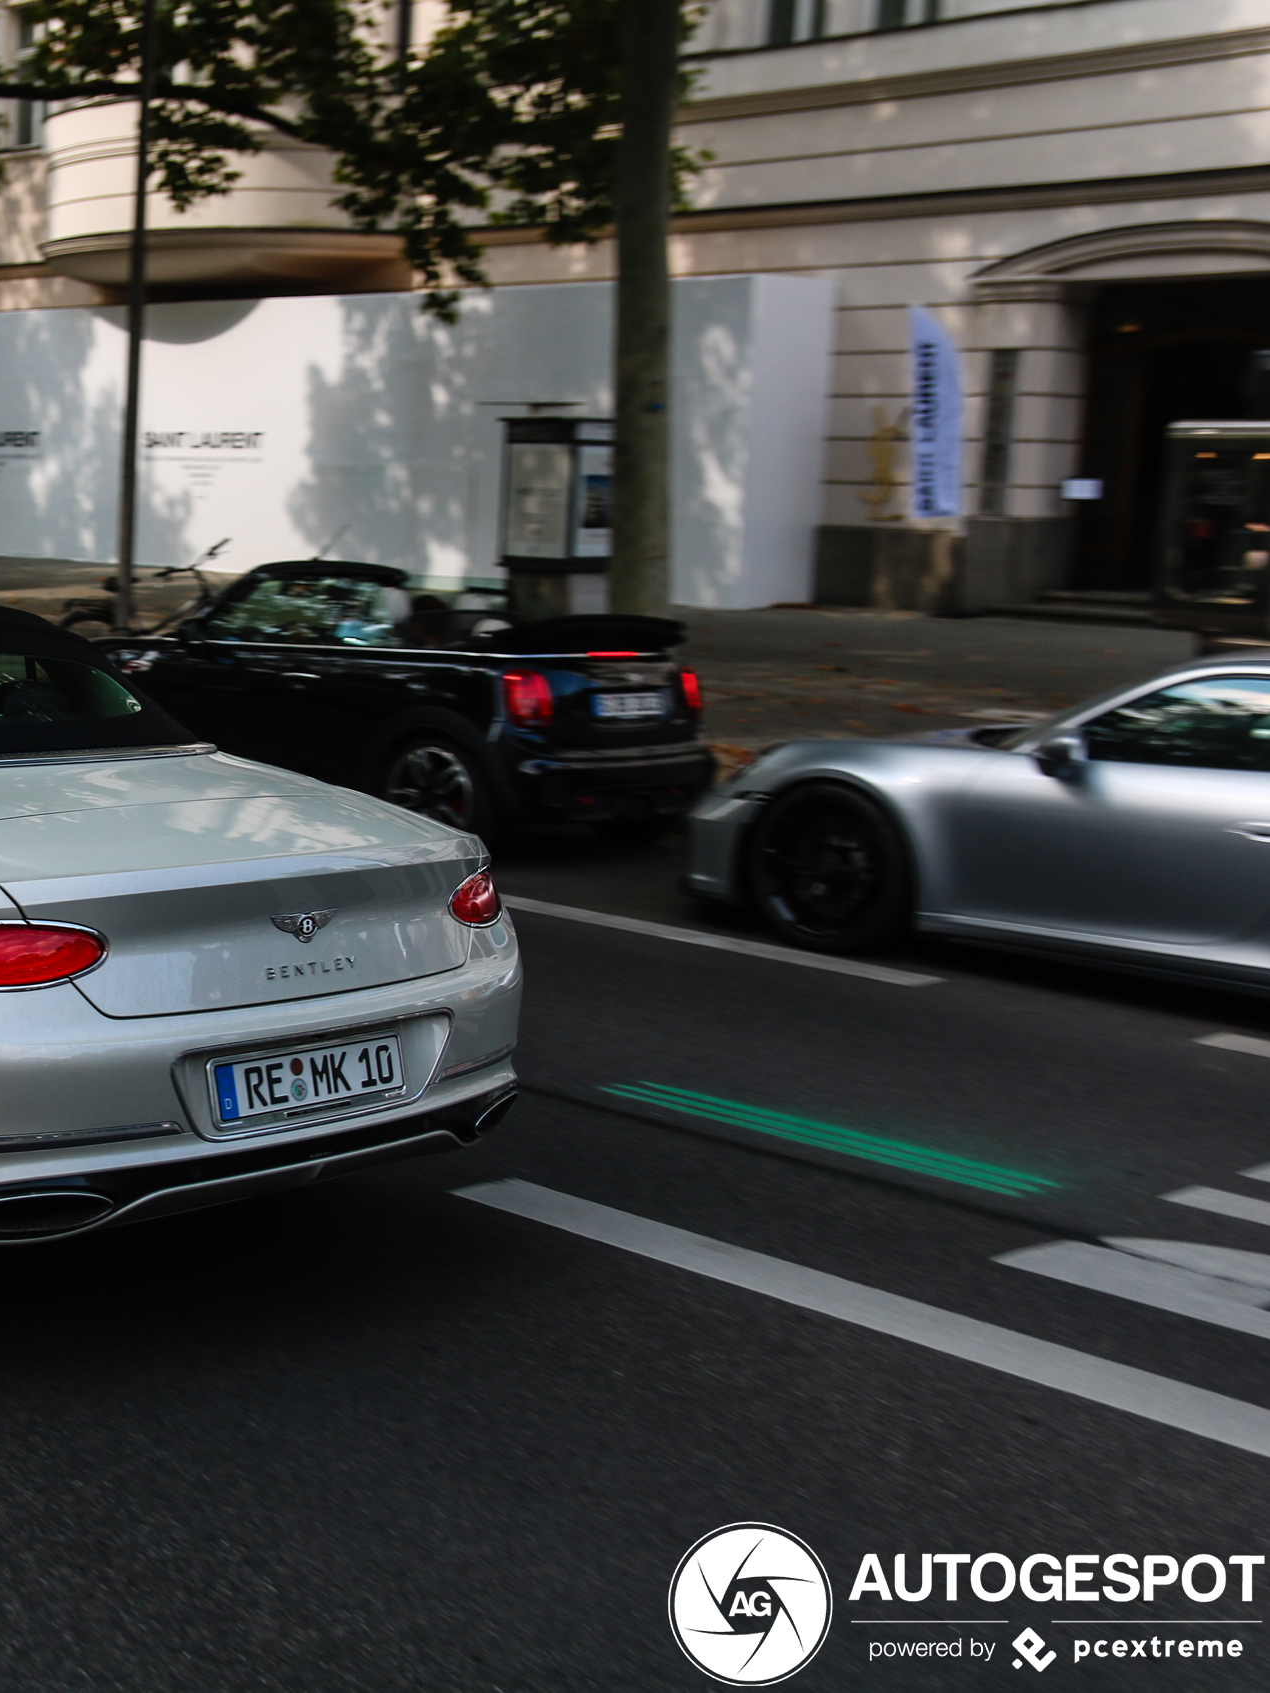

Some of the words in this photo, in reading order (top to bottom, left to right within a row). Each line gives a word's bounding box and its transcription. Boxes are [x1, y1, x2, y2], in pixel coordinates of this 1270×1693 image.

[266, 955, 357, 980] BENTLEY
[244, 1062, 290, 1110] RE
[309, 1051, 351, 1097] MK
[357, 1043, 394, 1088] 10
[224, 1097, 233, 1110] D
